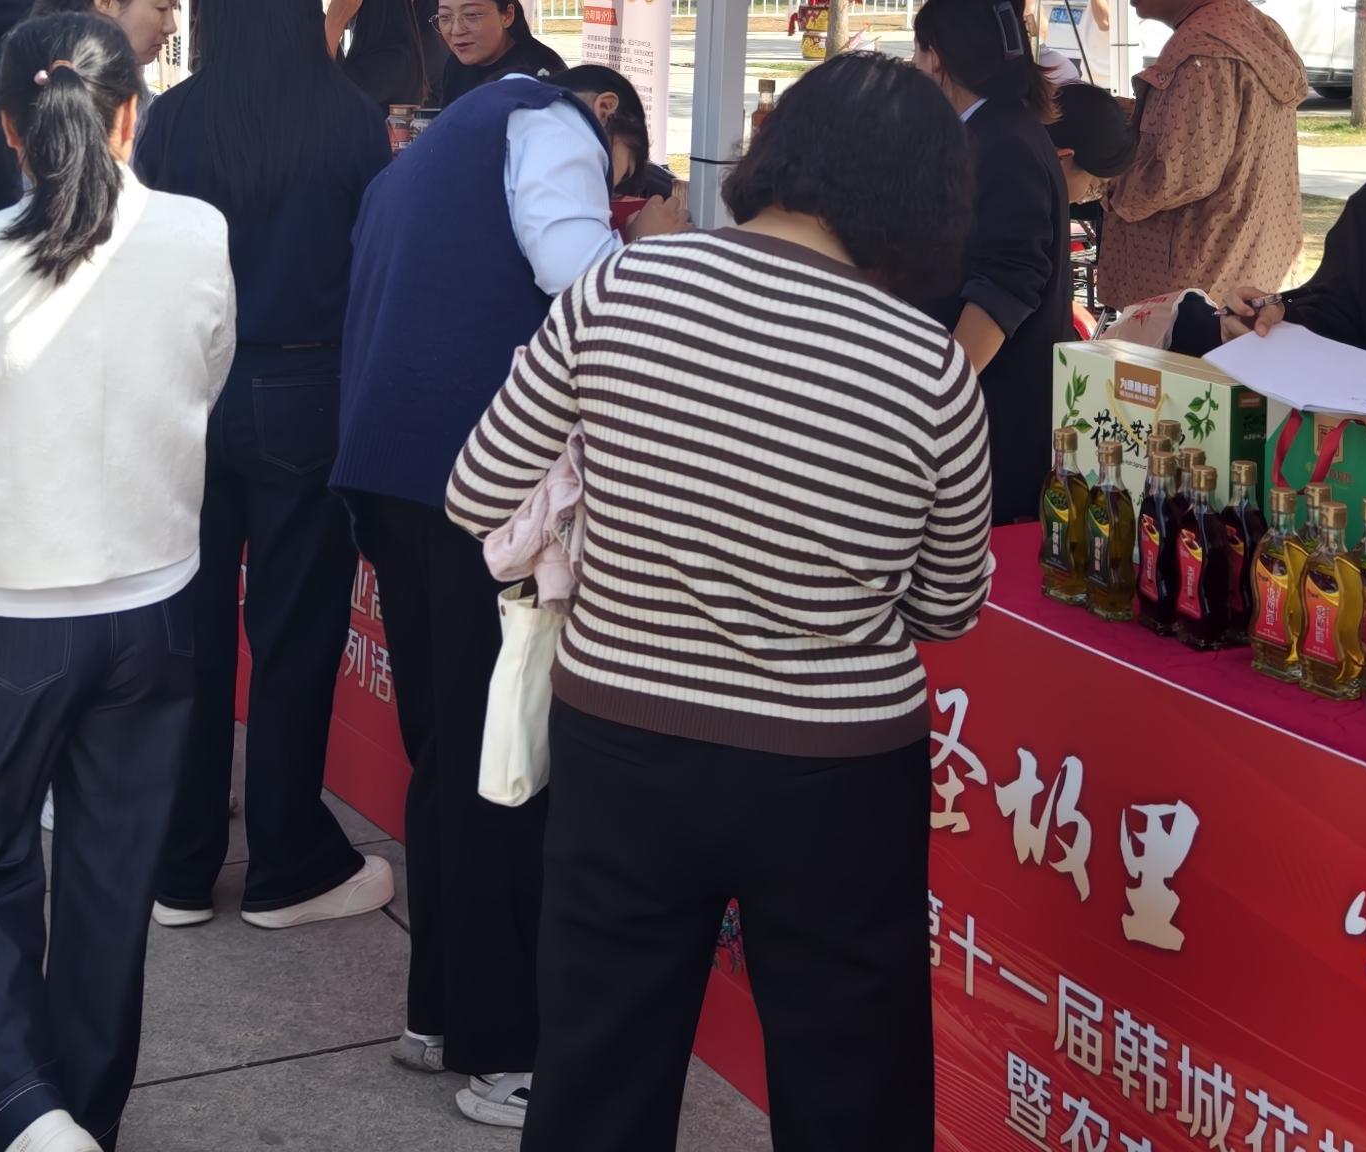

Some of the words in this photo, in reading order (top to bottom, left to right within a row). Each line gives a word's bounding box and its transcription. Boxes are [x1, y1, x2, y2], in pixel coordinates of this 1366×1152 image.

[927, 891, 1355, 1152] 十一届韩城花
[1005, 1050, 1153, 1152] 暨农
